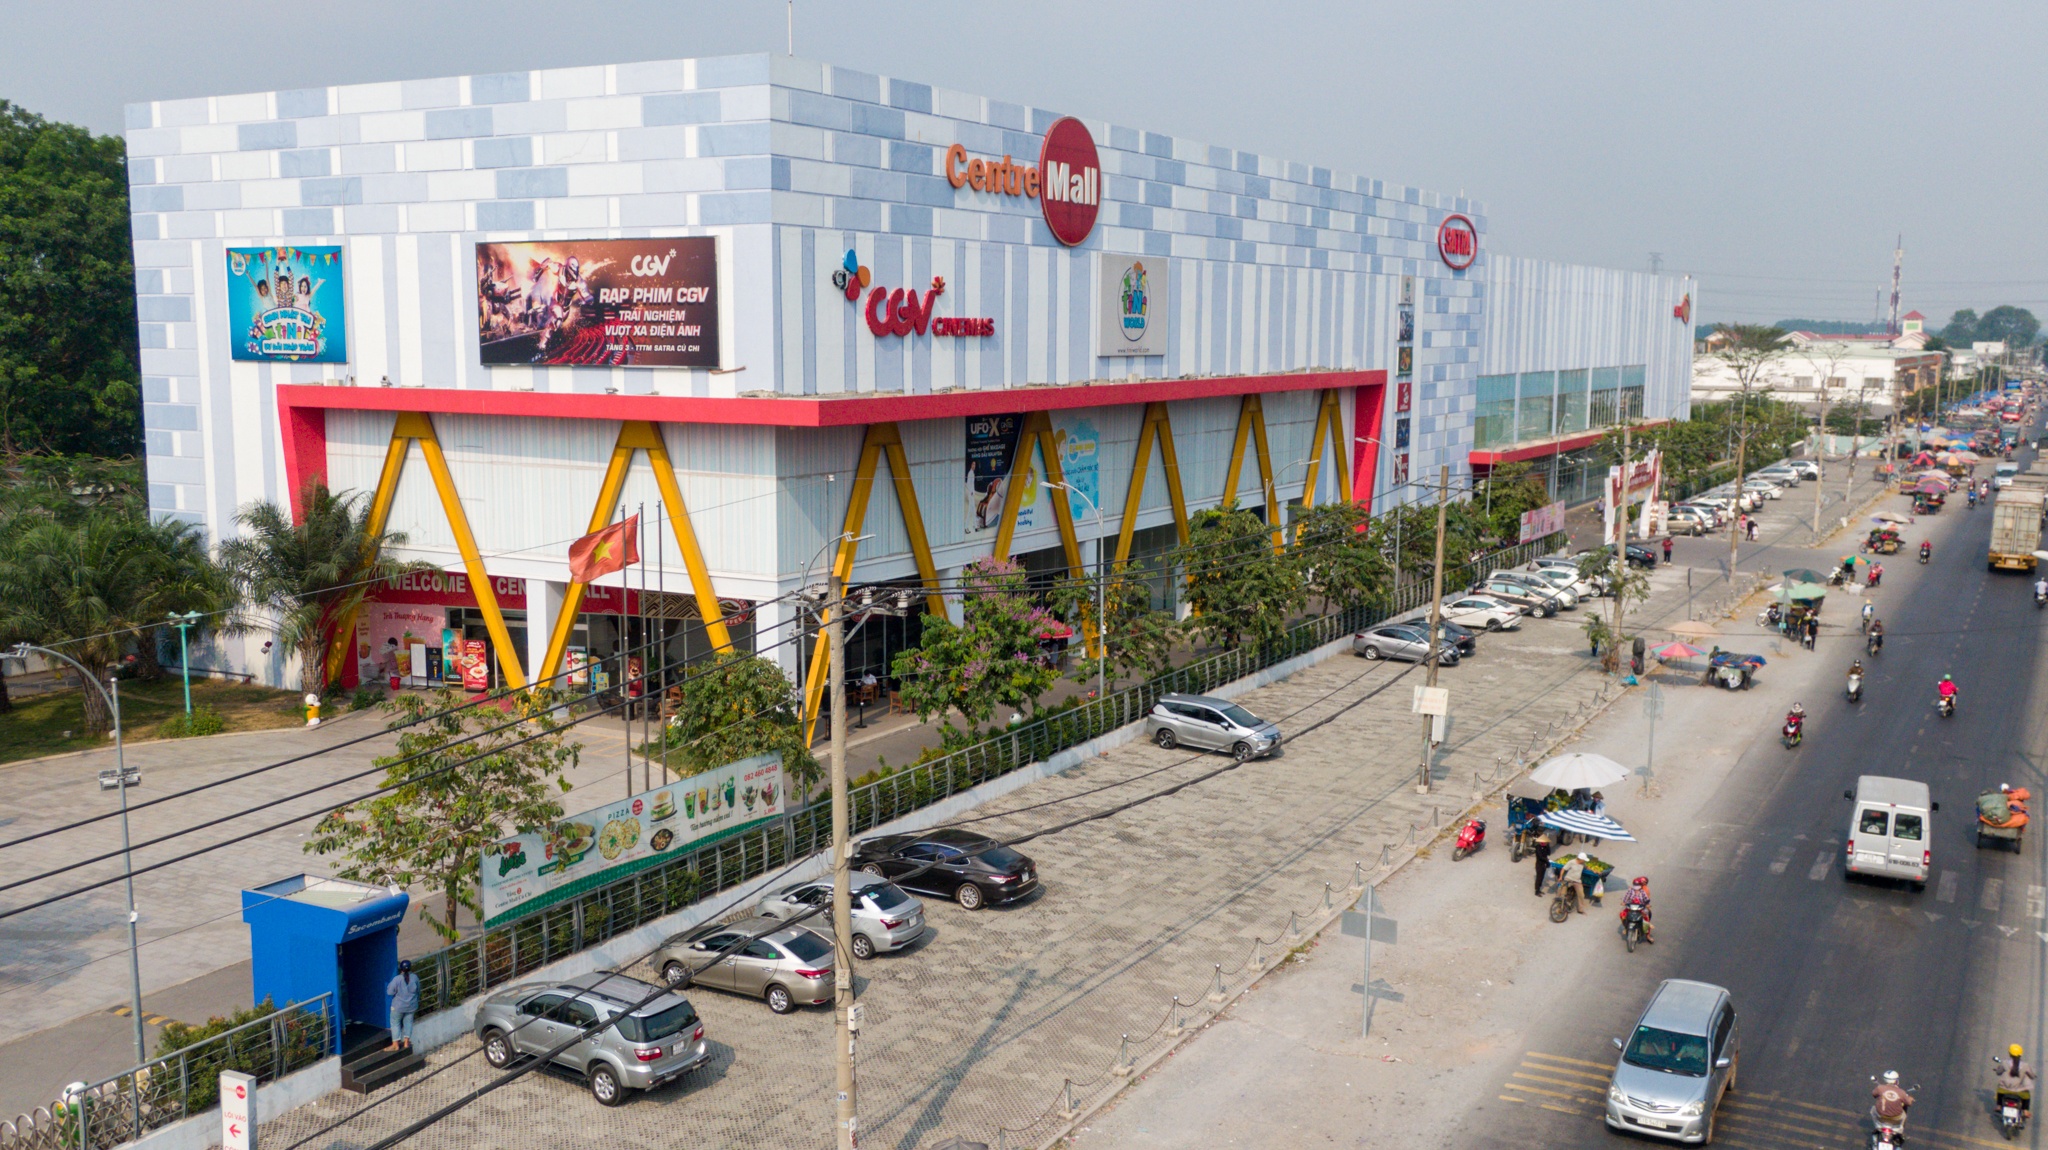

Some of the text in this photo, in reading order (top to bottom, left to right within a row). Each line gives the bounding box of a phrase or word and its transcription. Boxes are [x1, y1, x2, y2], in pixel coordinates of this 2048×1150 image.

[946, 143, 1098, 206] Centre Mall
[1443, 226, 1471, 256] SATRA
[631, 254, 671, 277] CGV
[599, 286, 710, 306] RẠP PHIM CGV
[643, 308, 686, 324] NGHIỆM
[865, 286, 995, 337] CGV CINEMAS
[633, 325, 648, 337] XA
[650, 323, 676, 338] ĐIỆN
[635, 344, 653, 352] TTTM
[654, 344, 676, 352] SATRA
[677, 342, 687, 352] CỦ
[688, 344, 700, 352] CHI
[388, 574, 466, 593] WELCOME
[743, 772, 754, 782] 082
[607, 808, 630, 820] PIZZA
[347, 910, 402, 934] Sacombank
